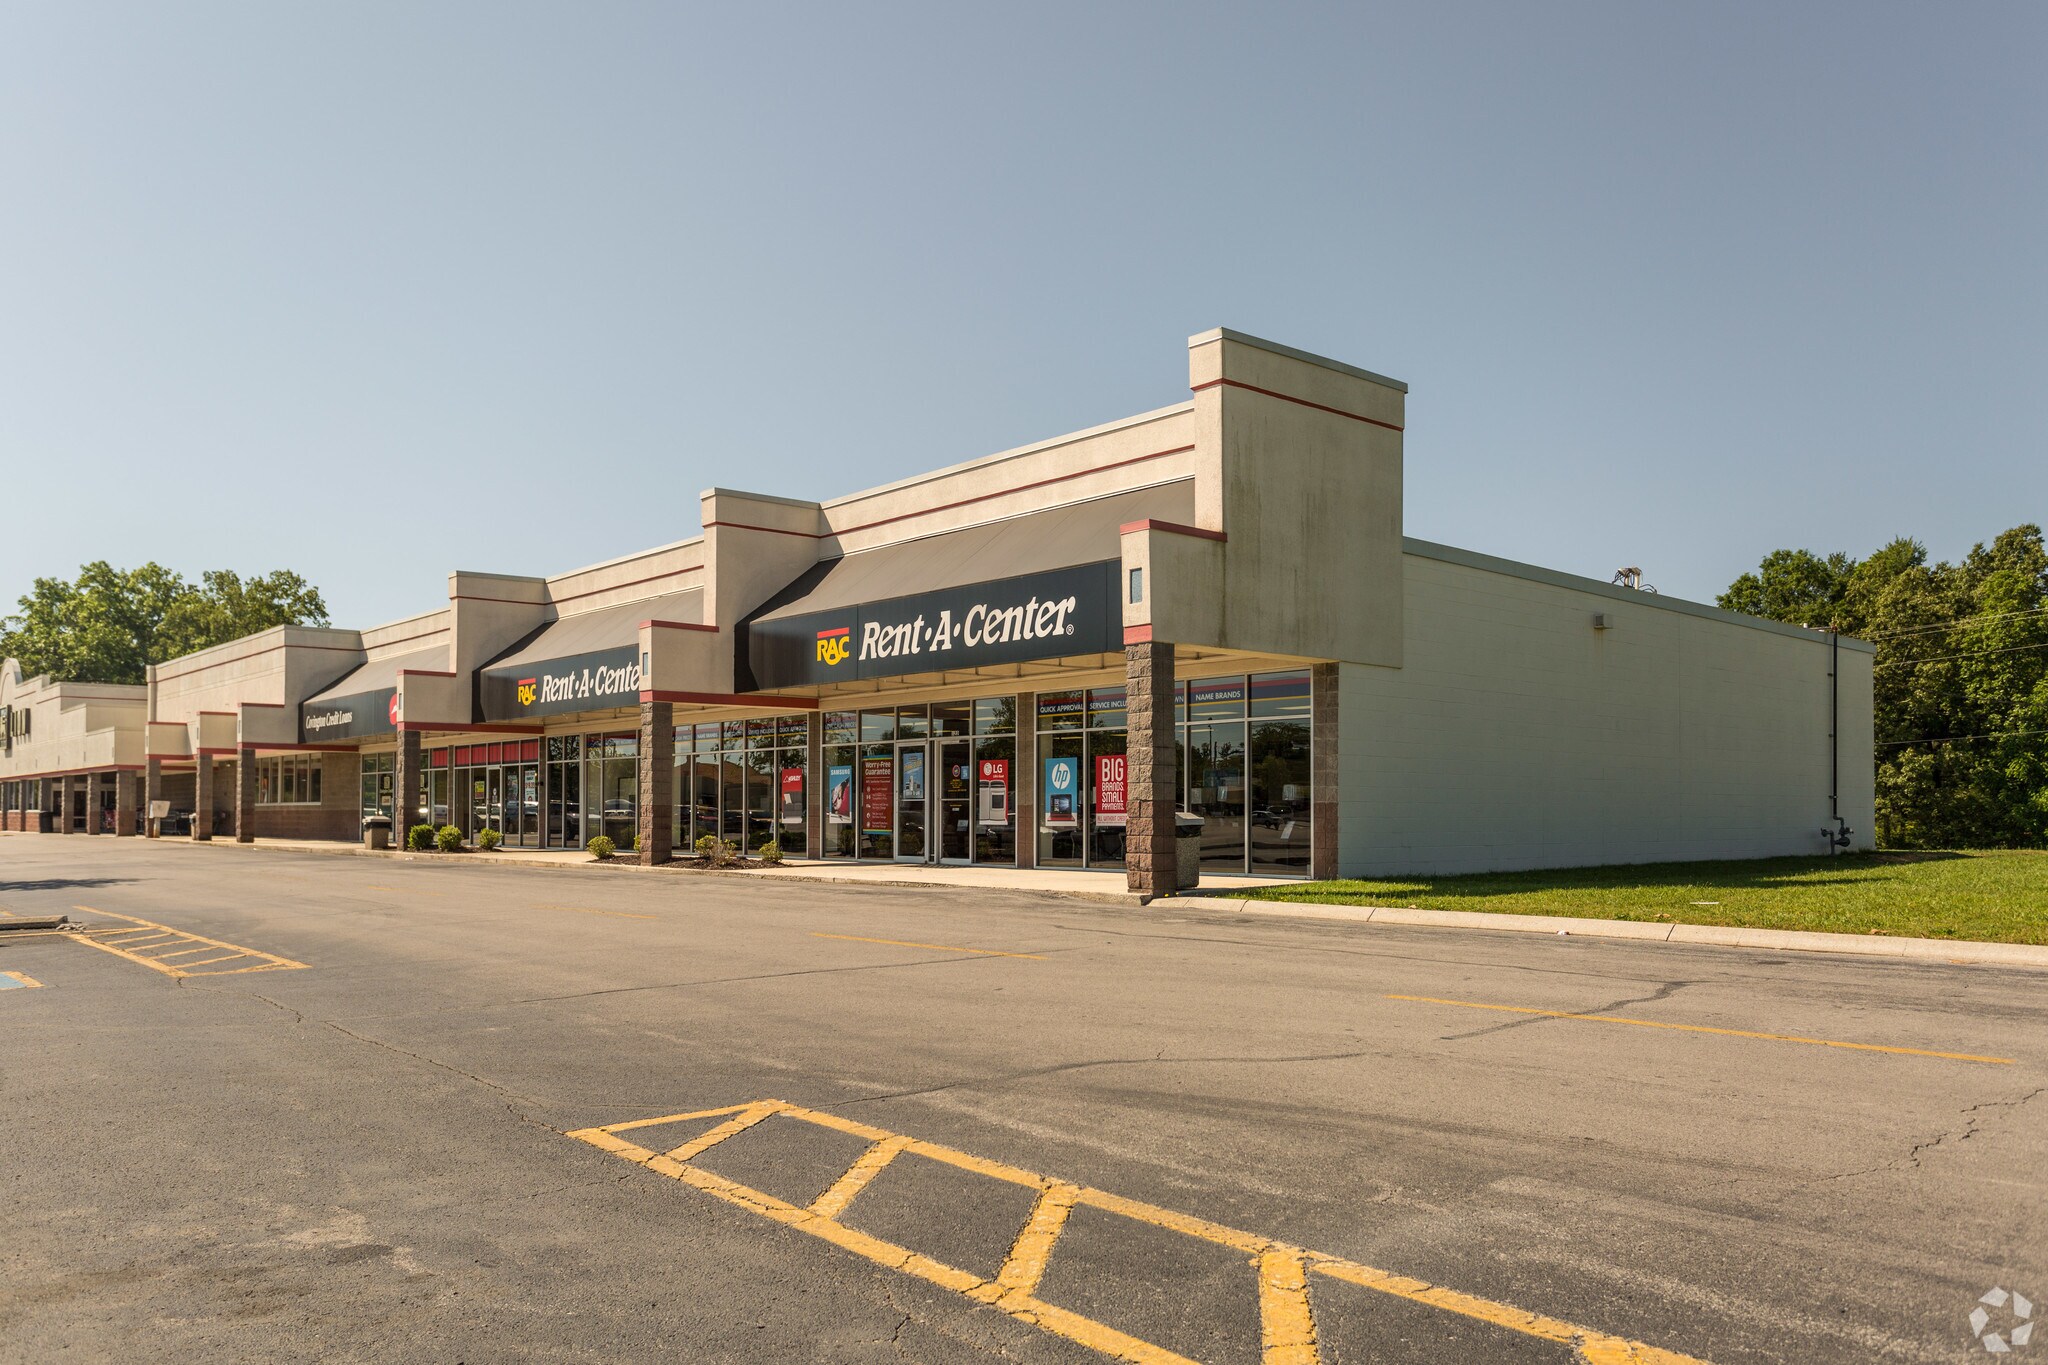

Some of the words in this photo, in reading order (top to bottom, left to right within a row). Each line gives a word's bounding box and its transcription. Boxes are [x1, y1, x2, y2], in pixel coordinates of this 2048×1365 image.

[816, 635, 850, 666] RAC
[517, 683, 537, 706] RAC
[1195, 692, 1214, 701] NAME
[1215, 690, 1241, 699] BRANDS
[1056, 703, 1084, 712] APPROVAL
[1089, 701, 1110, 710] SERVICE
[1110, 700, 1127, 708] INCLU
[305, 715, 326, 732] Covington
[325, 711, 339, 727] Credit
[339, 710, 353, 725] Loans
[830, 768, 850, 776] SAMSUNG
[992, 763, 1003, 774] LG
[1101, 757, 1124, 782] BIG
[1054, 763, 1069, 789] hp
[1101, 791, 1124, 803] SMALL
